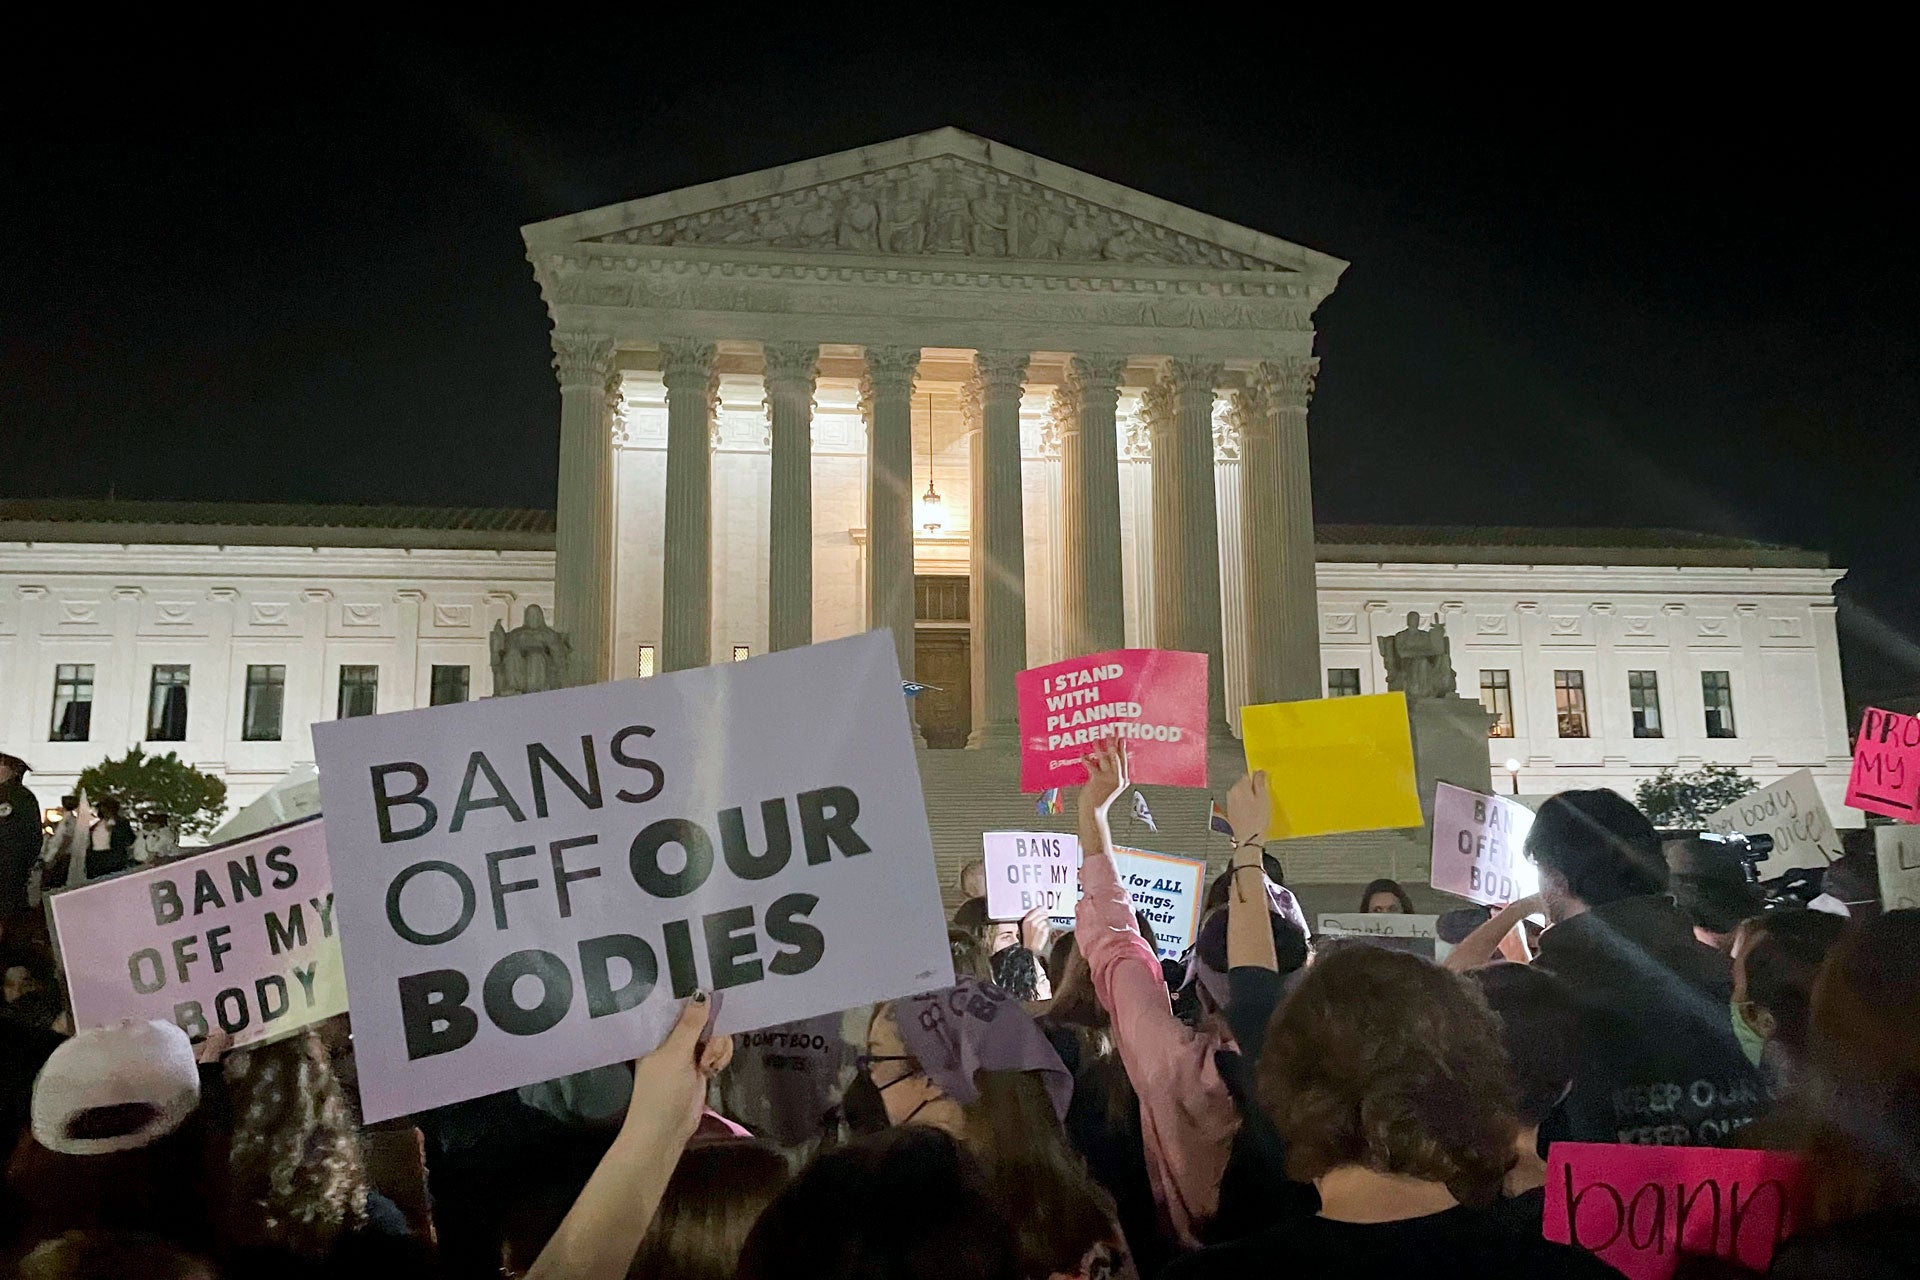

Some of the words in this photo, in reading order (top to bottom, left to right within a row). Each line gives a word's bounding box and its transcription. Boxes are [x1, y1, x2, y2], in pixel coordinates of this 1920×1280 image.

[1043, 678, 1051, 695] I
[1055, 664, 1123, 692] STAND
[1046, 686, 1100, 713] WITH
[1047, 702, 1142, 732] PLANNED
[1048, 722, 1182, 751] PARENTHOOD
[369, 725, 665, 844] BANS
[1858, 750, 1904, 789] MY
[1474, 800, 1514, 834] BAN
[1739, 790, 1797, 827] body
[1016, 838, 1061, 858] BANS
[1458, 829, 1499, 863] OFF
[385, 834, 602, 946] OFF
[629, 785, 872, 898] OUR
[1007, 864, 1042, 885] OFF
[1051, 865, 1068, 884] MY
[150, 845, 299, 926] BANS
[1129, 873, 1151, 889] for
[1152, 878, 1182, 894] ALL
[1021, 890, 1062, 910] BODY
[1132, 892, 1175, 910] eings,
[128, 925, 232, 995] OFF
[264, 892, 334, 956] MY
[1154, 932, 1182, 945] ALITY
[398, 892, 825, 1061] BODIES
[173, 961, 318, 1044] BODY
